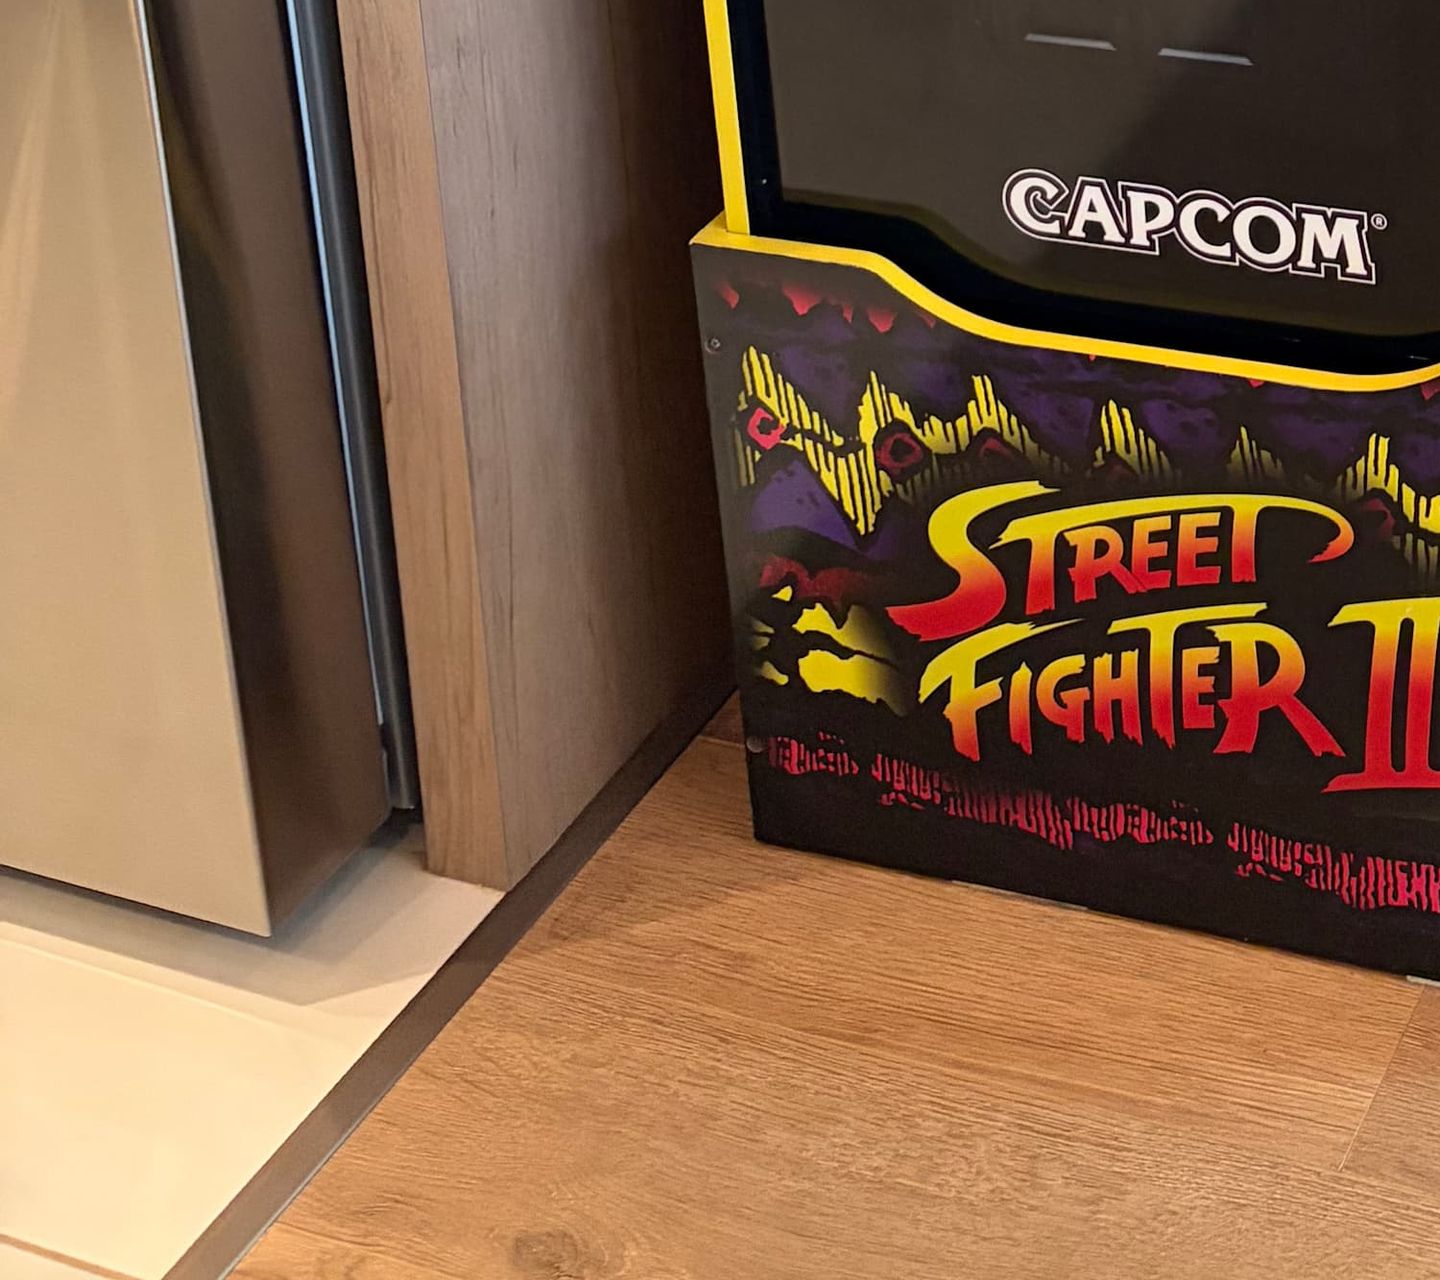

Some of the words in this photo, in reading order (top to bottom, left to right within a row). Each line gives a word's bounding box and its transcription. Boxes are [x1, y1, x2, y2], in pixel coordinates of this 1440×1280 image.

[1002, 168, 1377, 285] CAPCOM
[884, 479, 1355, 641] STREET
[918, 602, 1345, 761] FIGHTER
